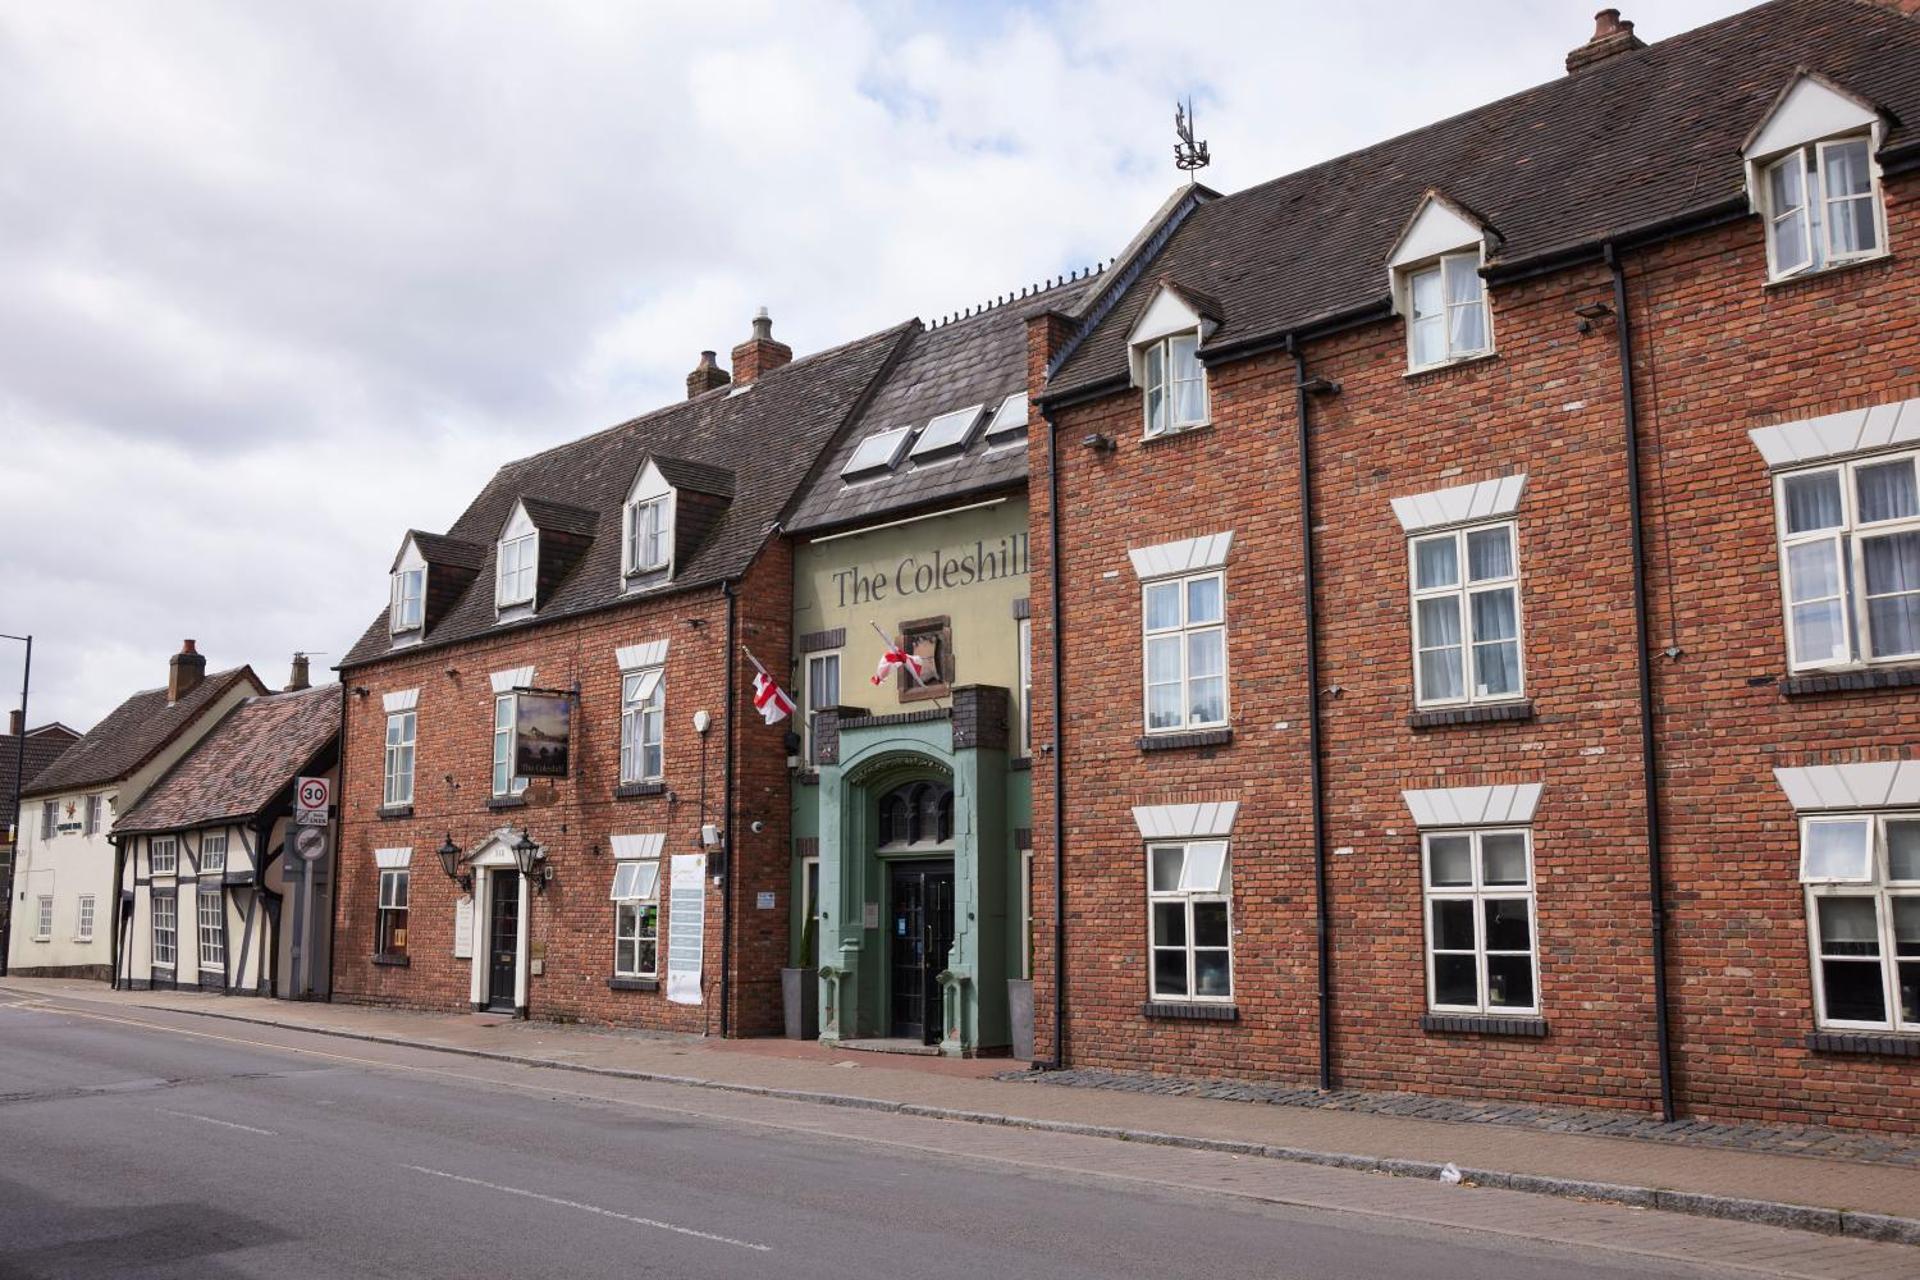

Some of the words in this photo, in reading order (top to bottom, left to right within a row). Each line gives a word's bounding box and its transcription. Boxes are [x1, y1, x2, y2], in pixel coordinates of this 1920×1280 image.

[833, 566, 887, 607] The
[896, 532, 1030, 596] Coleshill
[304, 788, 323, 800] 30
